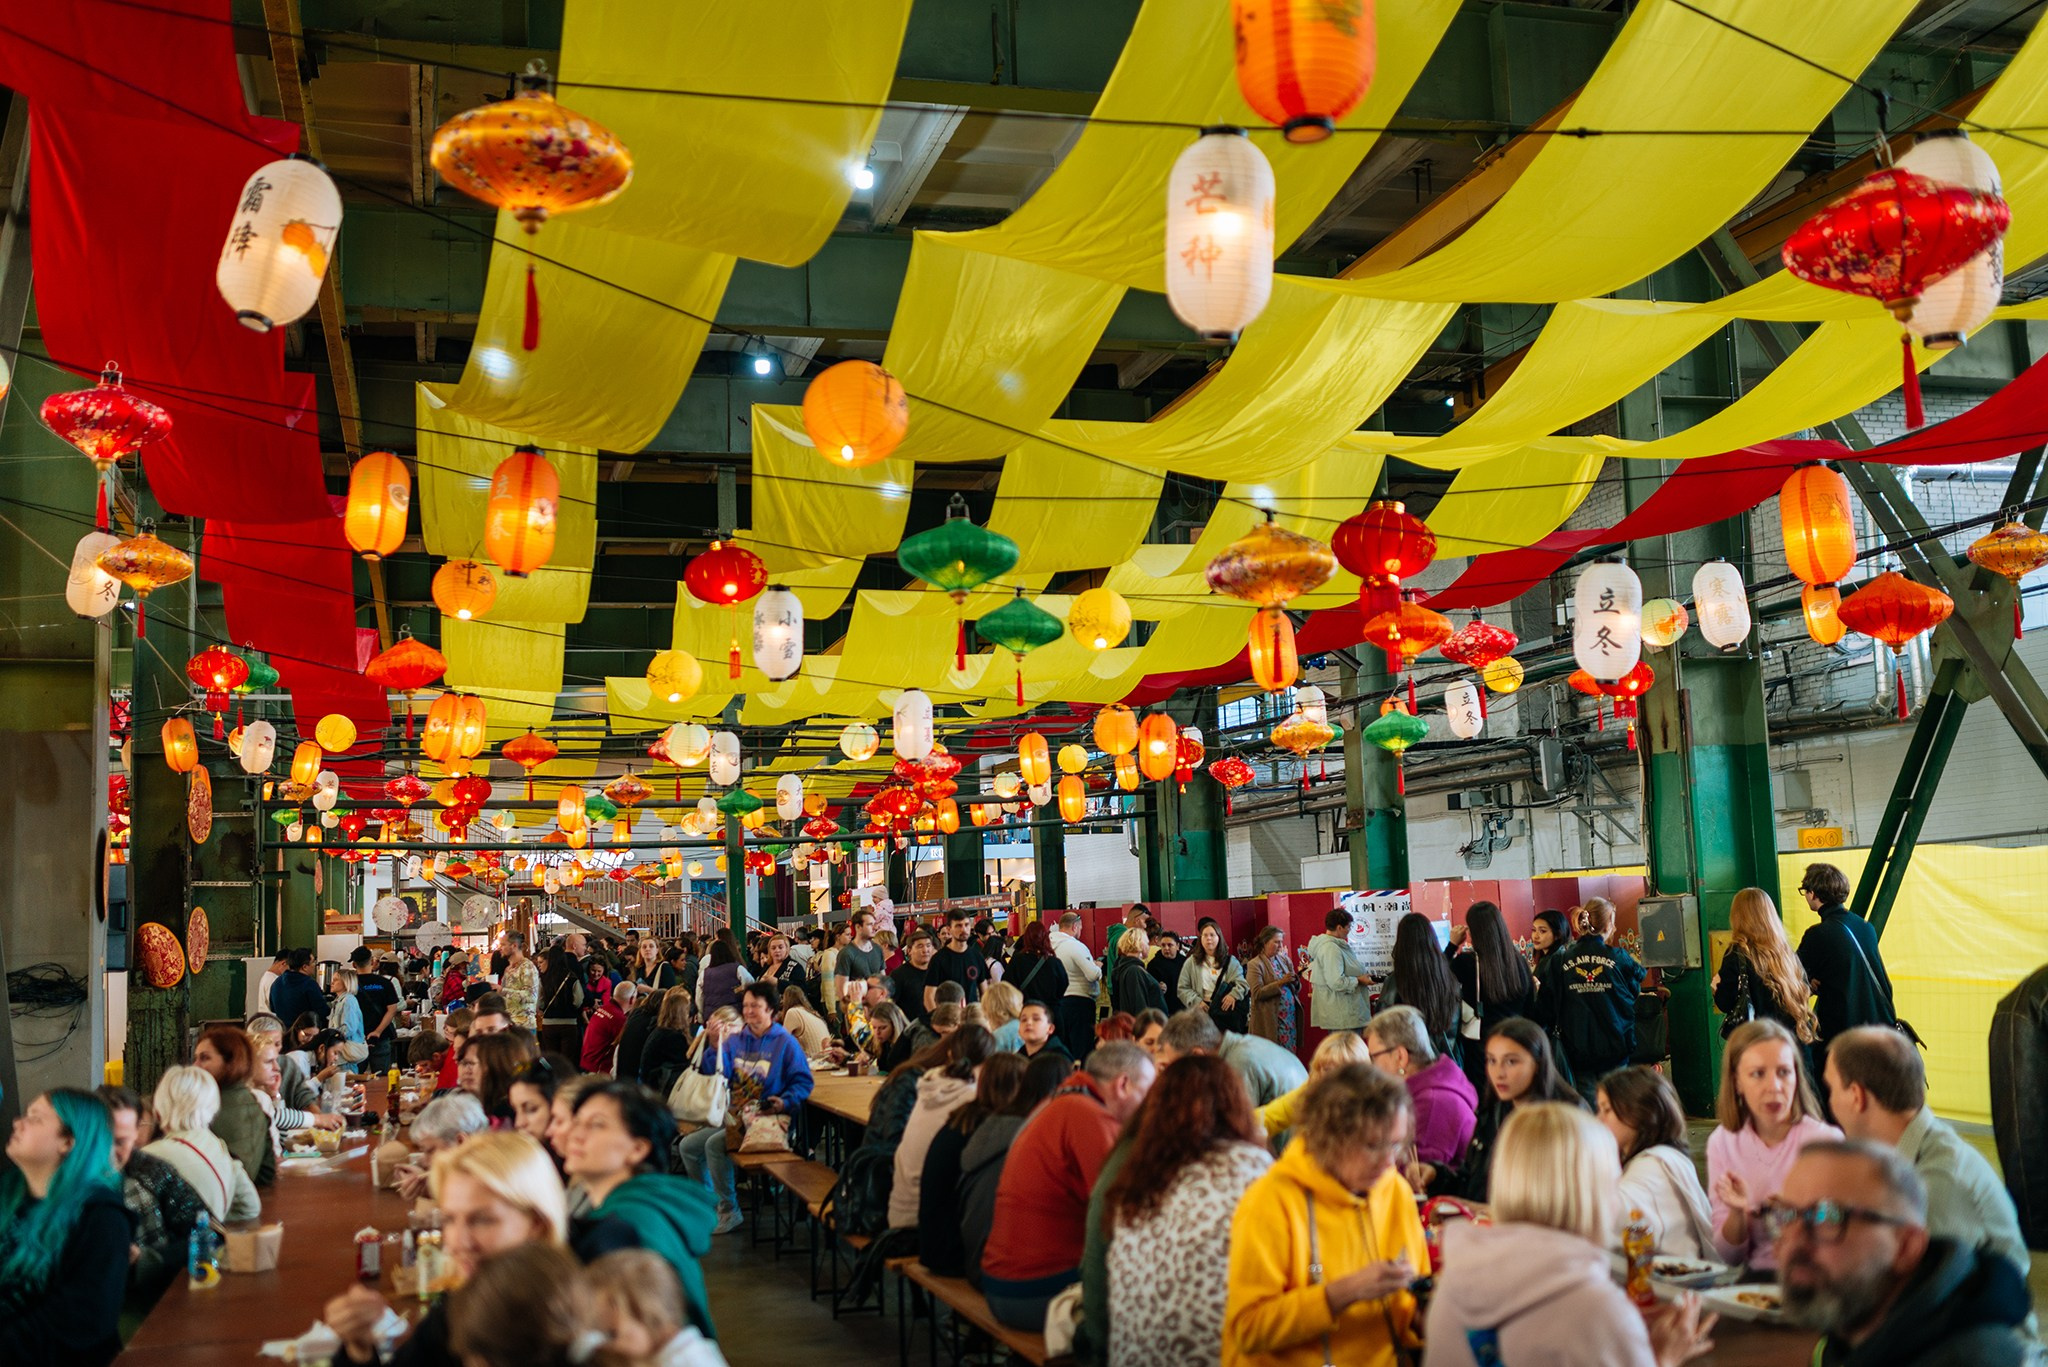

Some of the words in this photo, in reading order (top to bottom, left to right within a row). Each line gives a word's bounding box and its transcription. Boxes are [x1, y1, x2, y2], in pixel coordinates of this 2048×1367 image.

[225, 176, 273, 264] 霜降
[1180, 171, 1228, 284] 芒种
[1590, 587, 1623, 656] 立冬
[1709, 577, 1734, 625] 寒露
[779, 609, 797, 660] 小雪
[1461, 692, 1478, 725] 立冬
[1591, 955, 1616, 969] FORCE
